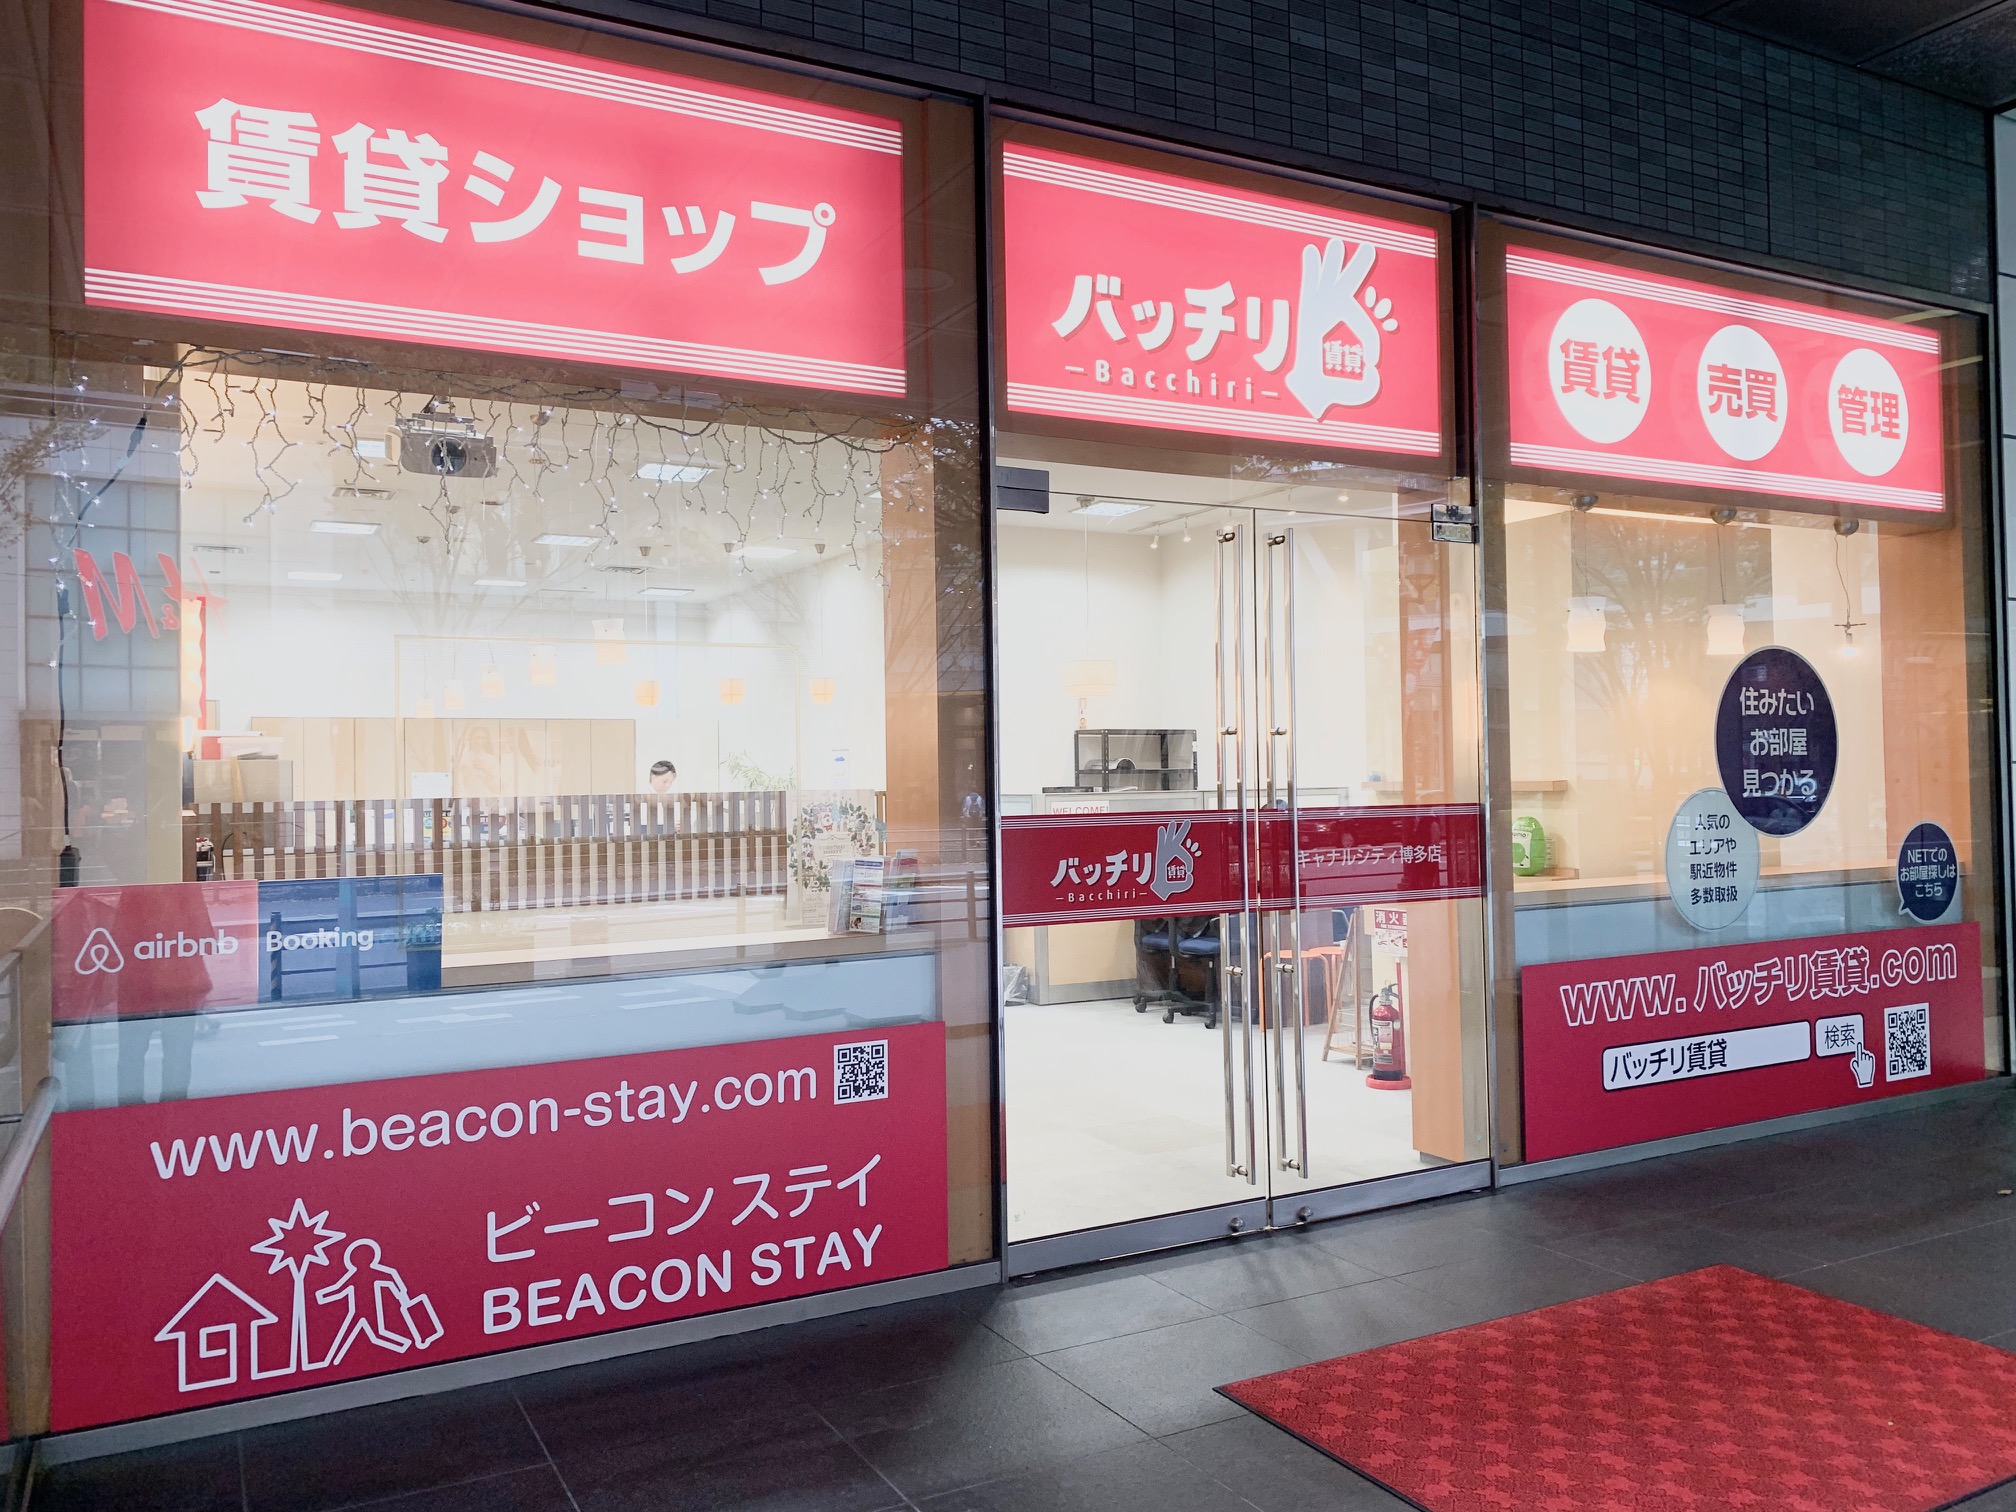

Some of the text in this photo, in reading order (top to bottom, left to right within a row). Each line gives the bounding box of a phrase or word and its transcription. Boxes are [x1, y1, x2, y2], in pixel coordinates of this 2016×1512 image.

[194, 97, 837, 286] 賃貸ショップ
[1051, 273, 1364, 374] バッチリ 賃貸
[1094, 358, 1252, 401] Bacchiri
[1559, 338, 1641, 404] 賃貸
[1707, 363, 1779, 424] 売買
[1837, 384, 1901, 440] 管理
[1740, 686, 1815, 716] 住みたい
[1750, 728, 1808, 757] お部屋
[1742, 768, 1818, 798] 見つかる
[1695, 814, 1731, 831] 人気の
[1297, 845, 1441, 868] キャナルシティ博多店
[1690, 838, 1737, 855] エリアや
[1907, 847, 1948, 864] NETでの
[1050, 849, 1152, 887] バッチリ
[1690, 861, 1737, 880] 駅近物件
[1900, 864, 1956, 881] お部屋探しは
[1068, 888, 1136, 903] Bacchiri
[1691, 885, 1738, 905] 多数取扱
[1915, 882, 1943, 898] こちら
[133, 928, 239, 960] airbnb
[266, 927, 374, 952] Booking
[1560, 942, 1958, 1027] www.バッチリ賃貸.com
[1824, 1023, 1856, 1050] 検索
[1610, 1038, 1727, 1083] バッチリ賃貸
[150, 1065, 818, 1180] www.beacon-stay.com
[487, 1153, 883, 1263] ビーコン ステイ
[483, 1223, 883, 1336] BEACON STAY
